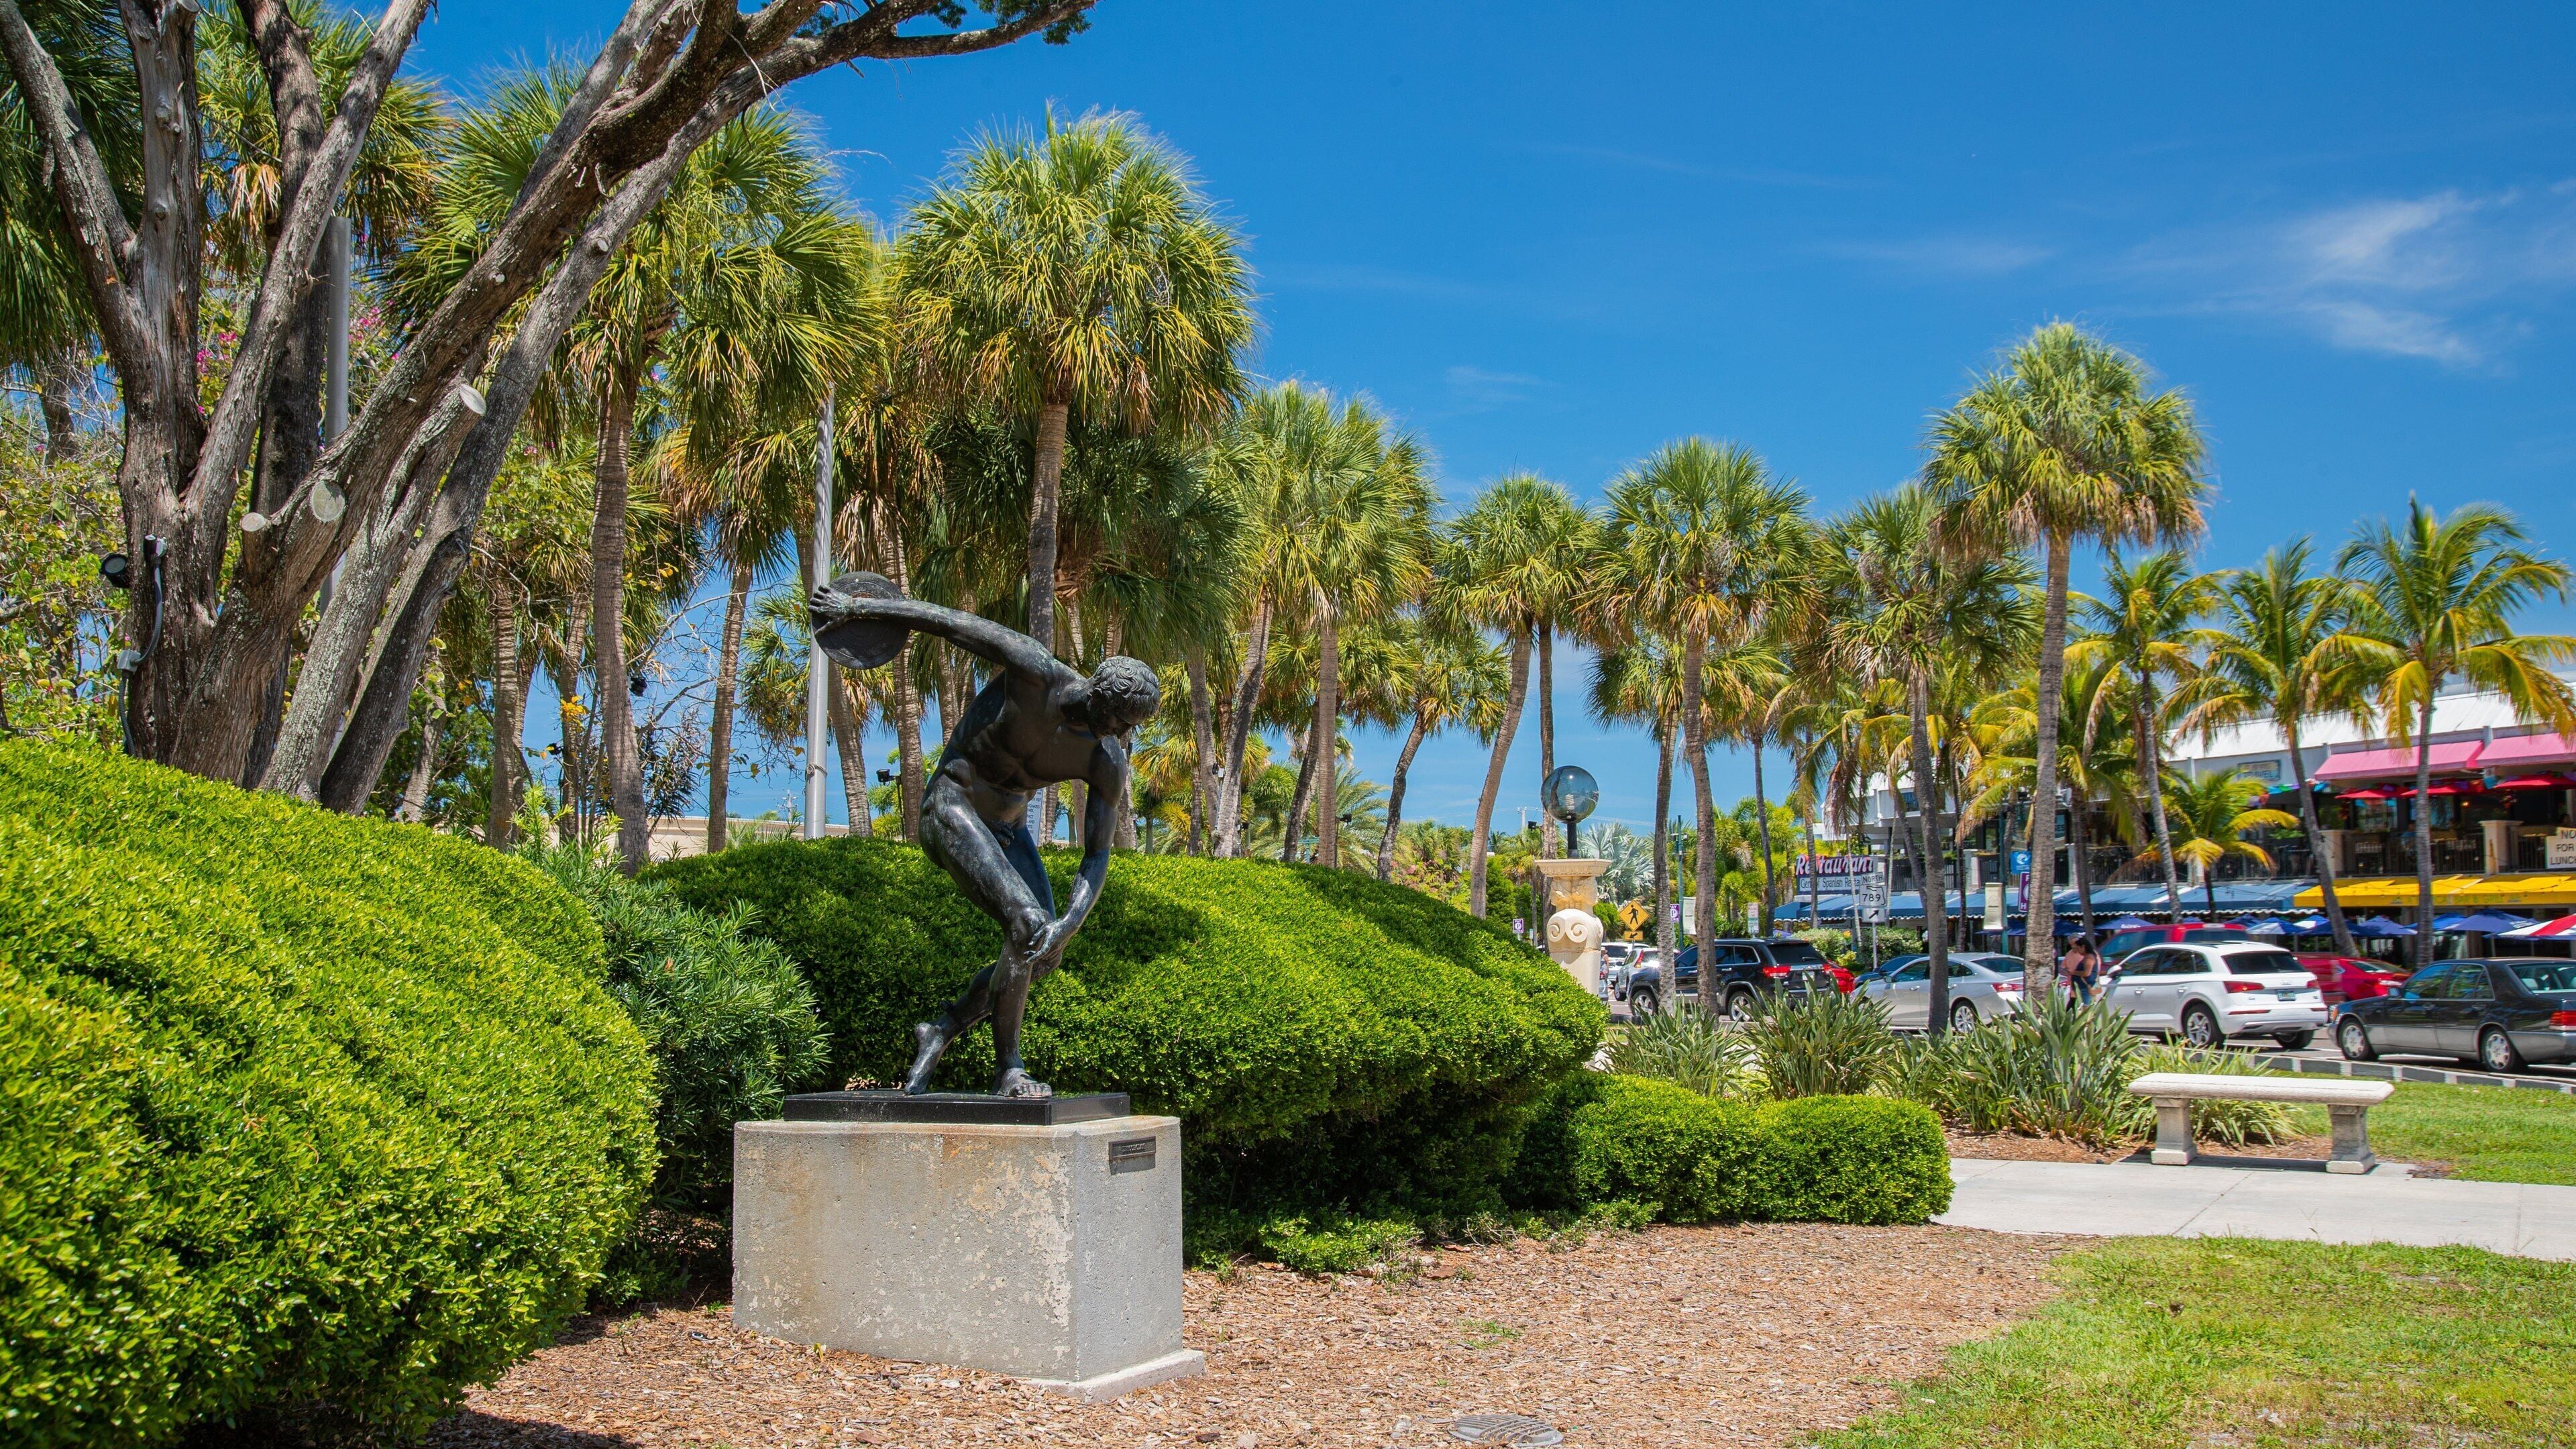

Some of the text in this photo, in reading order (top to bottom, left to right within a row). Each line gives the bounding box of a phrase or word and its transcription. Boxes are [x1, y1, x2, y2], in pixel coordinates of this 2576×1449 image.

[2557, 843, 2575, 852] FOR
[1863, 875, 1883, 883] NORTH
[1823, 877, 1843, 890] Spanish
[1862, 894, 1881, 902] 789
